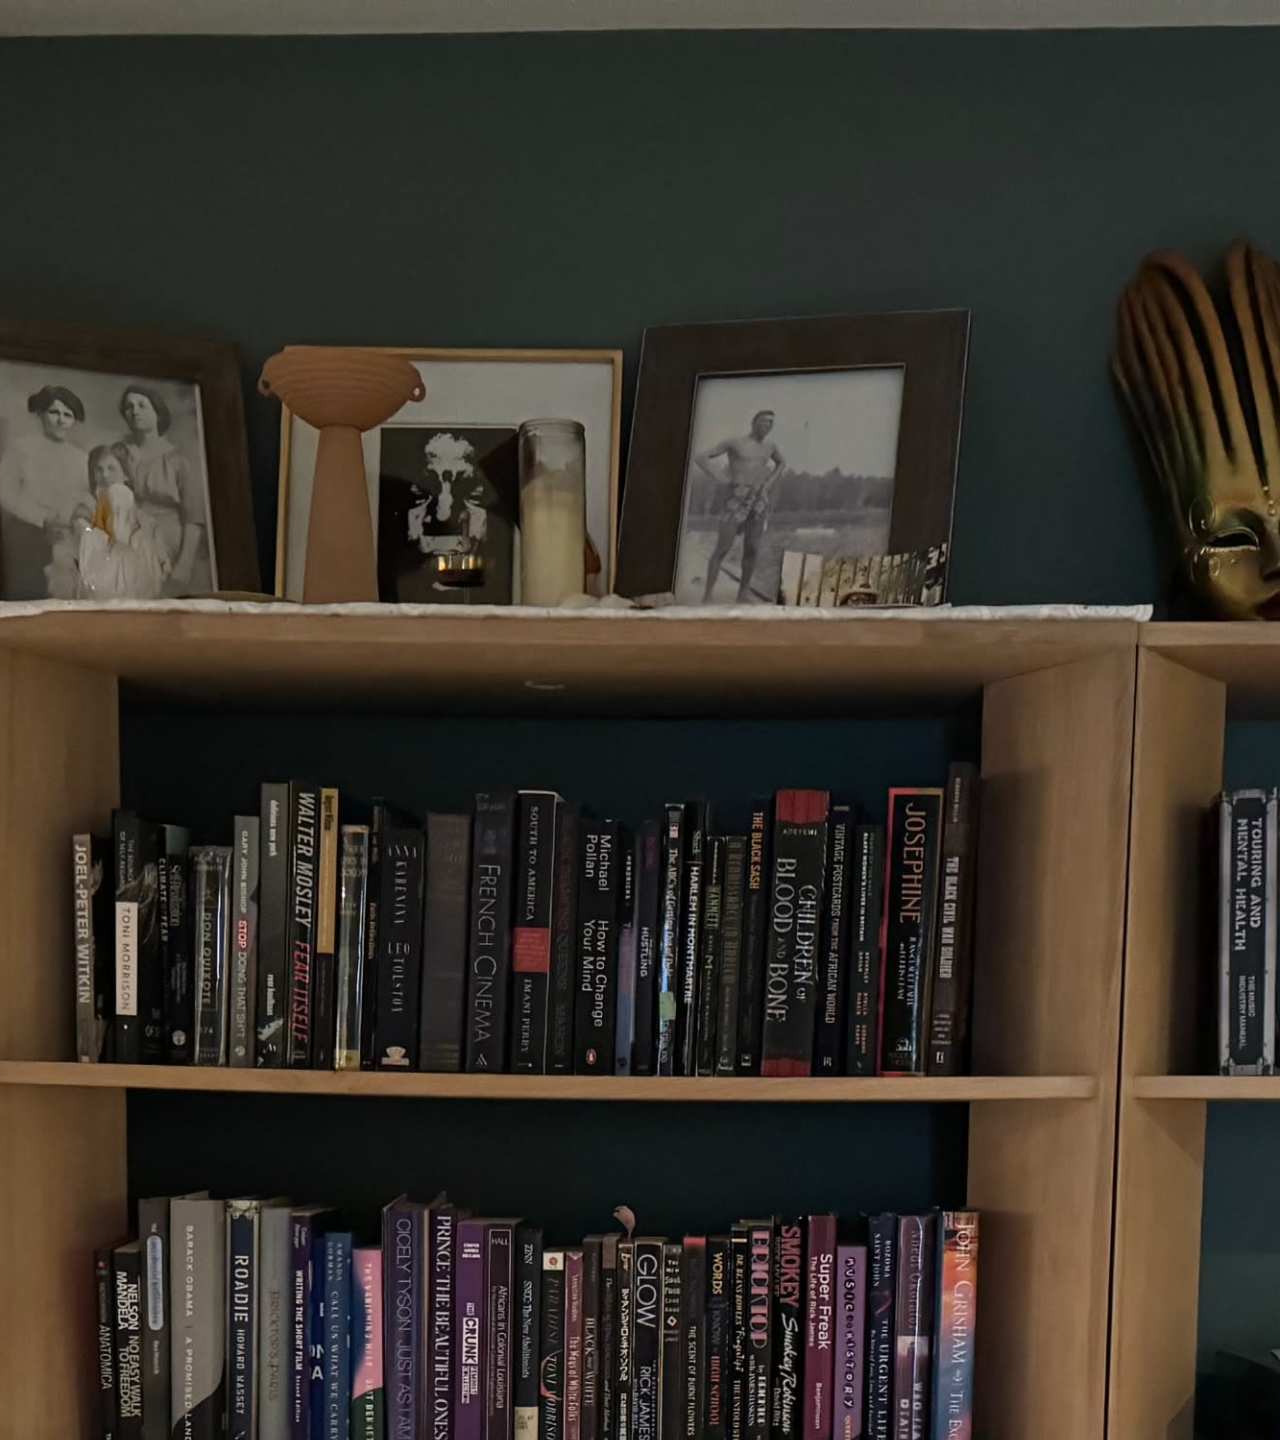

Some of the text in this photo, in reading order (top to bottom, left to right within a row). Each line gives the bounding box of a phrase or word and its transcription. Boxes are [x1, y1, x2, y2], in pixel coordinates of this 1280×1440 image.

[294, 791, 316, 928] WALTER MOSLEY
[585, 834, 598, 879] Pollan
[598, 834, 613, 892] Michael
[773, 857, 797, 933] BLOOD
[899, 801, 928, 924] JOSEPHINE
[1234, 818, 1249, 951] MENTAL HEALTH
[1249, 816, 1263, 929] TOURING AND
[75, 843, 92, 1004] JOEL-PETER WITKIN
[472, 864, 500, 1043] FRENCH CINEMA
[581, 919, 595, 992] Your Mind
[793, 884, 818, 985] CHILDREN
[592, 919, 610, 1028] How to Change
[766, 963, 790, 1022] BONE
[434, 1215, 452, 1273] PRINCE
[778, 1224, 801, 1309] SMOKEY
[952, 1222, 974, 1272] JOHN
[116, 1271, 139, 1330] NELSON MANDELA
[434, 1274, 452, 1308] THE
[636, 1253, 658, 1329] GLOW
[817, 1252, 833, 1351] Super Freak
[951, 1280, 973, 1365] GRISHAM
[434, 1310, 451, 1397] BEAUTIFUL
[947, 1391, 964, 1415] THE
